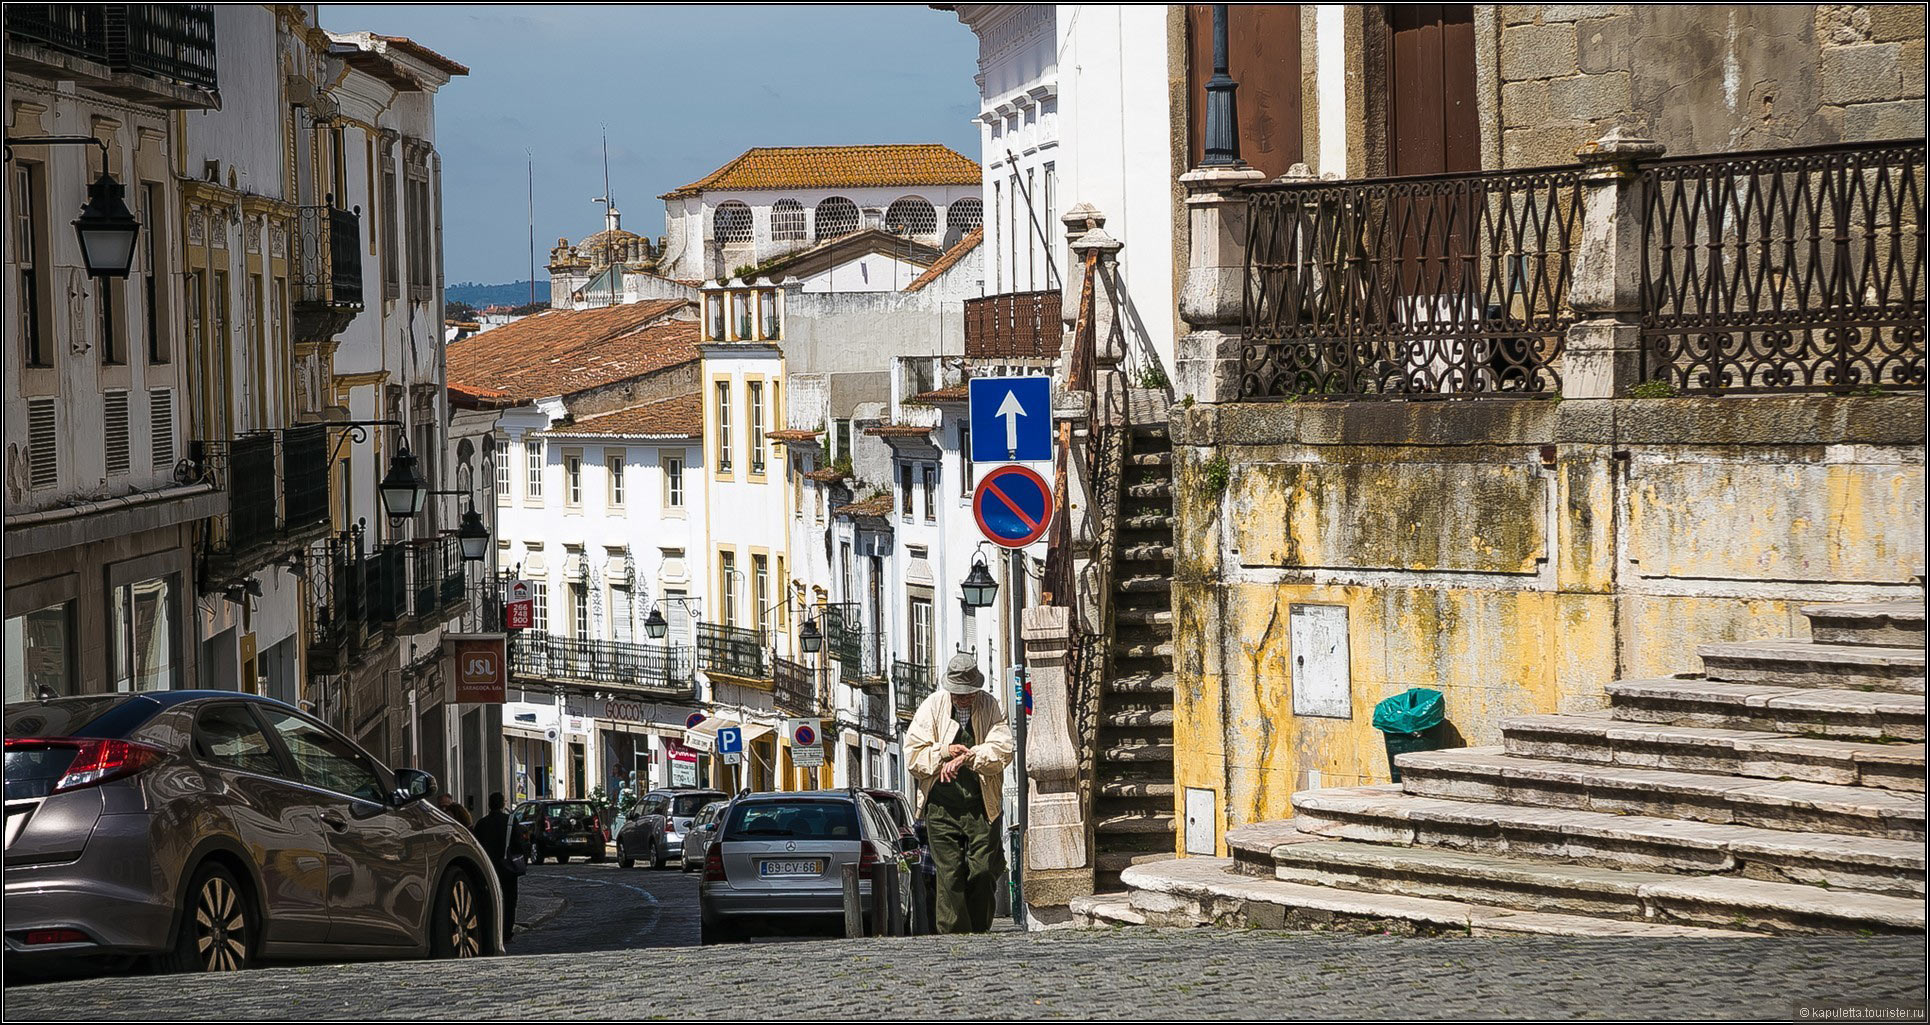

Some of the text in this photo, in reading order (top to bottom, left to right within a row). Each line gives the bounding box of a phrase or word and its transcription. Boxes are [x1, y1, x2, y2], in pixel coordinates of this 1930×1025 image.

[512, 603, 528, 611] 266
[512, 616, 528, 624] 900
[465, 659, 495, 676] JSL
[605, 702, 640, 721] GOCCO
[722, 730, 737, 751] P
[767, 862, 816, 873] 69-CV-66
